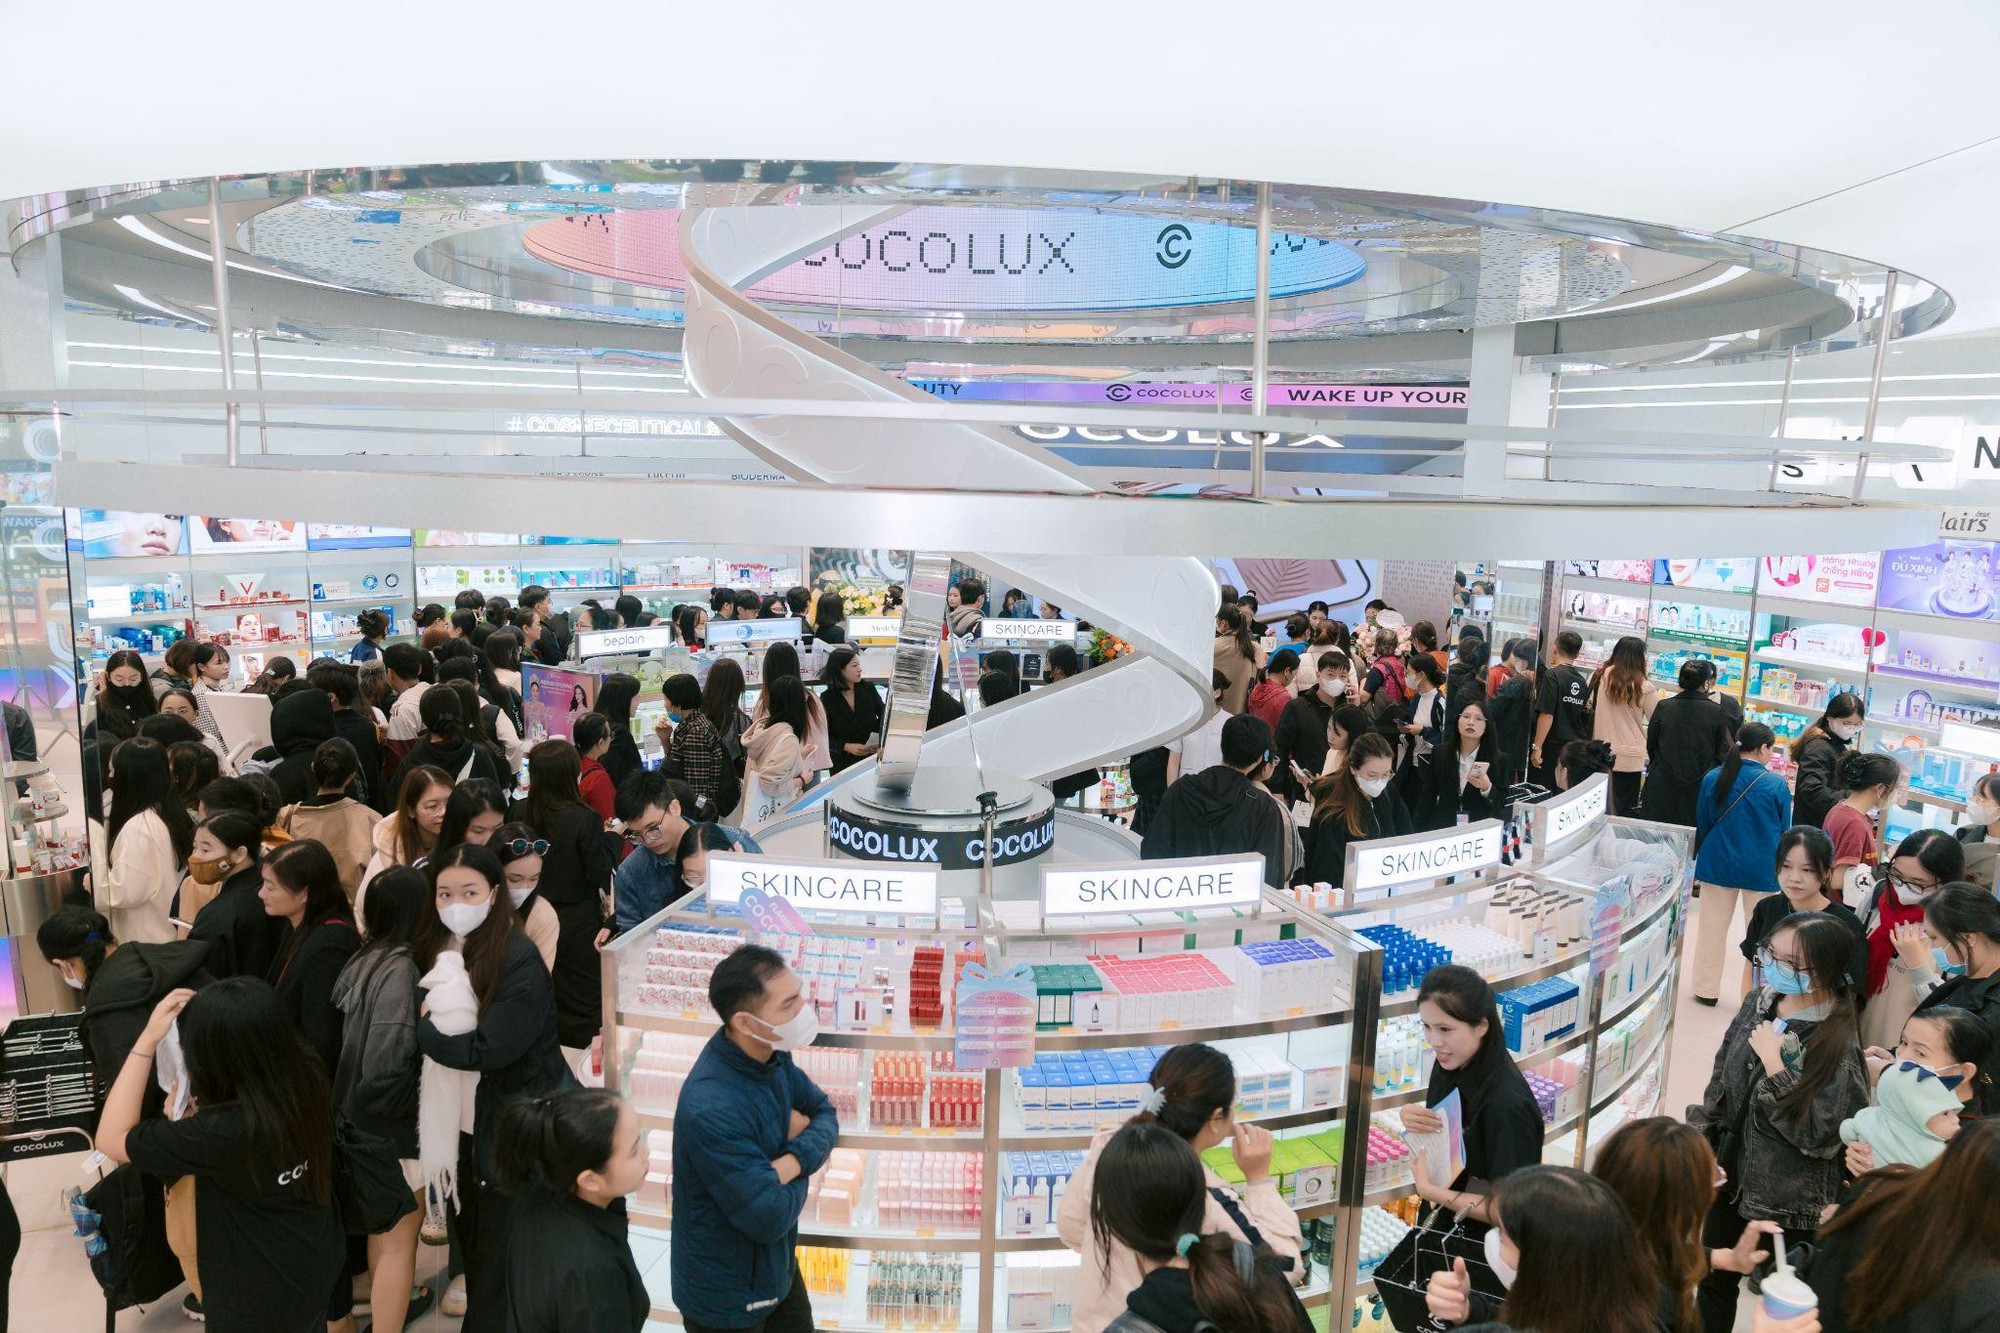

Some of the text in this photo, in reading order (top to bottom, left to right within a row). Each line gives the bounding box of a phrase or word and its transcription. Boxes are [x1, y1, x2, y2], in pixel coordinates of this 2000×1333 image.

[801, 230, 1075, 274] OCOLUX
[1136, 388, 1216, 399] COCOLUX
[1287, 388, 1467, 404] WAKE UP YOUR
[603, 634, 645, 648] beplain
[995, 624, 1063, 636] SKINCARE
[1558, 789, 1603, 831] SKINCARE
[831, 815, 1055, 862] COCOLUX COCOLUX
[1380, 838, 1485, 876] SKINCARE
[741, 871, 904, 902] SKINCARE
[1078, 872, 1234, 903] SKINCARE
[13, 1140, 65, 1153] COCOLUX
